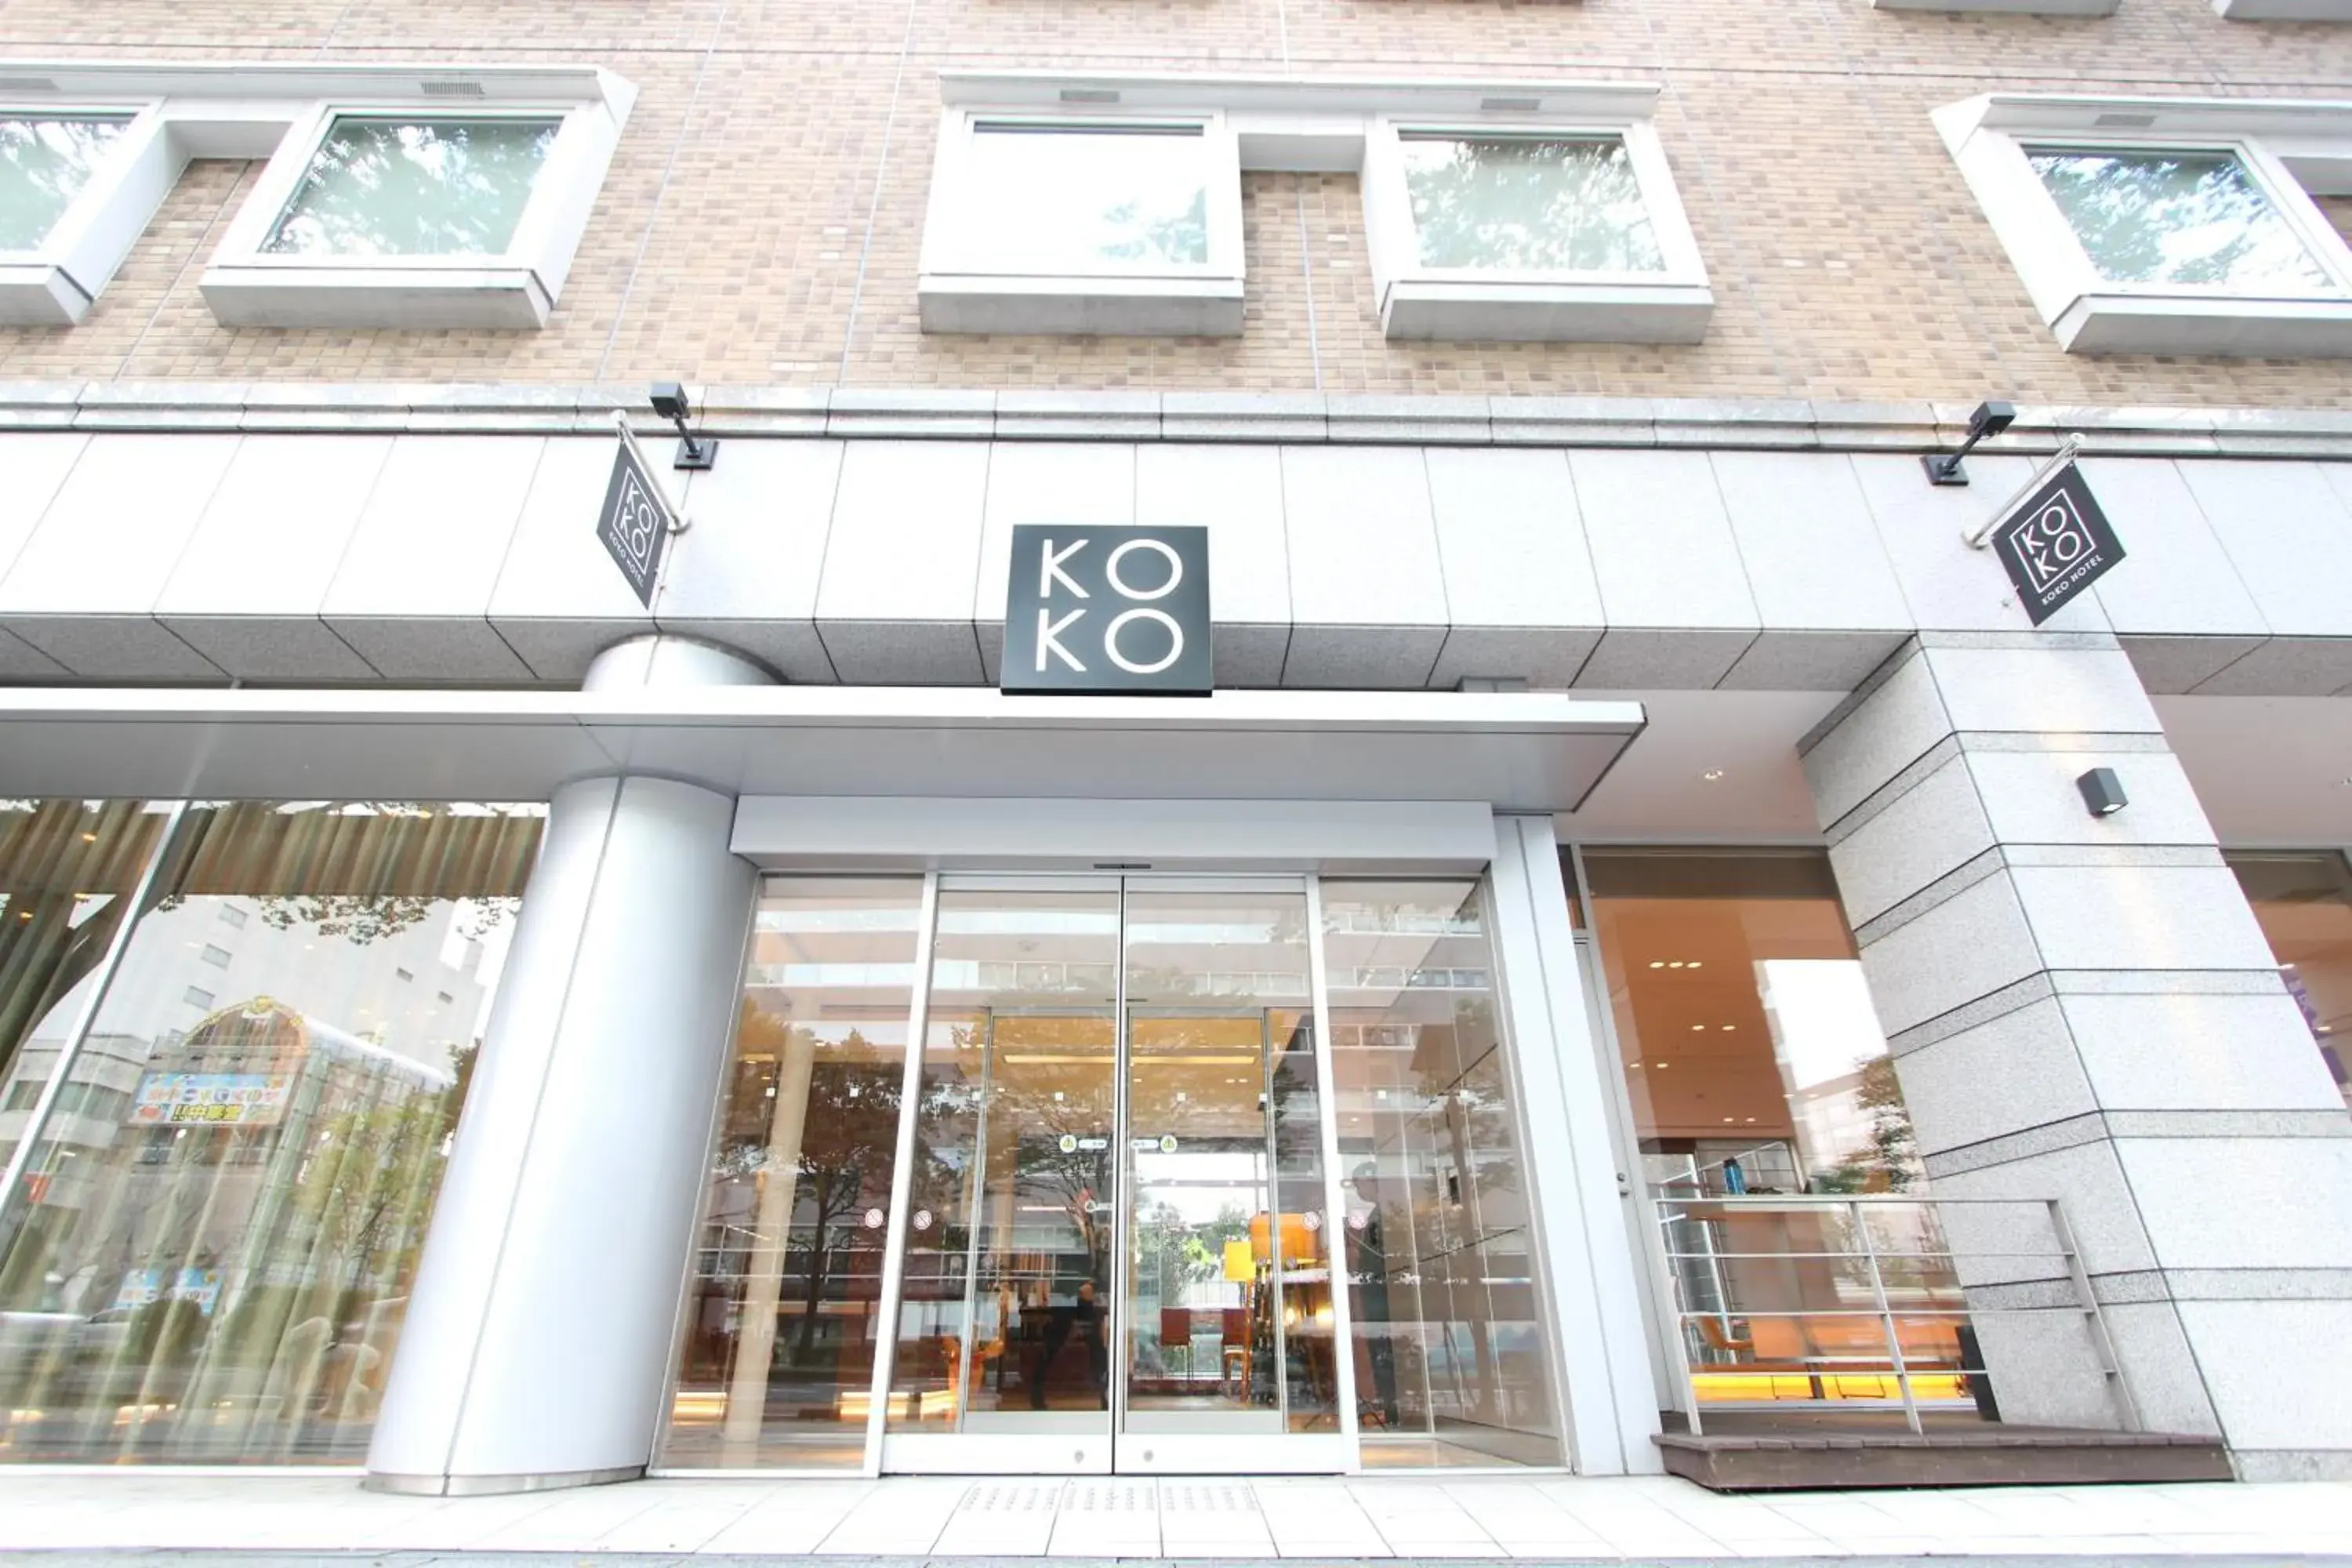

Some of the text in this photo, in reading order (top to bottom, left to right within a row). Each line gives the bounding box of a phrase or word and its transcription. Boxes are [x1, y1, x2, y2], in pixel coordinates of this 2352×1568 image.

[619, 507, 647, 557] KO
[626, 480, 653, 533] KO
[2020, 506, 2067, 554] KO
[1040, 539, 1183, 601] KO
[2034, 531, 2082, 581] KO
[2041, 554, 2105, 606] KOKO HOTEL
[1035, 608, 1184, 674] KO
